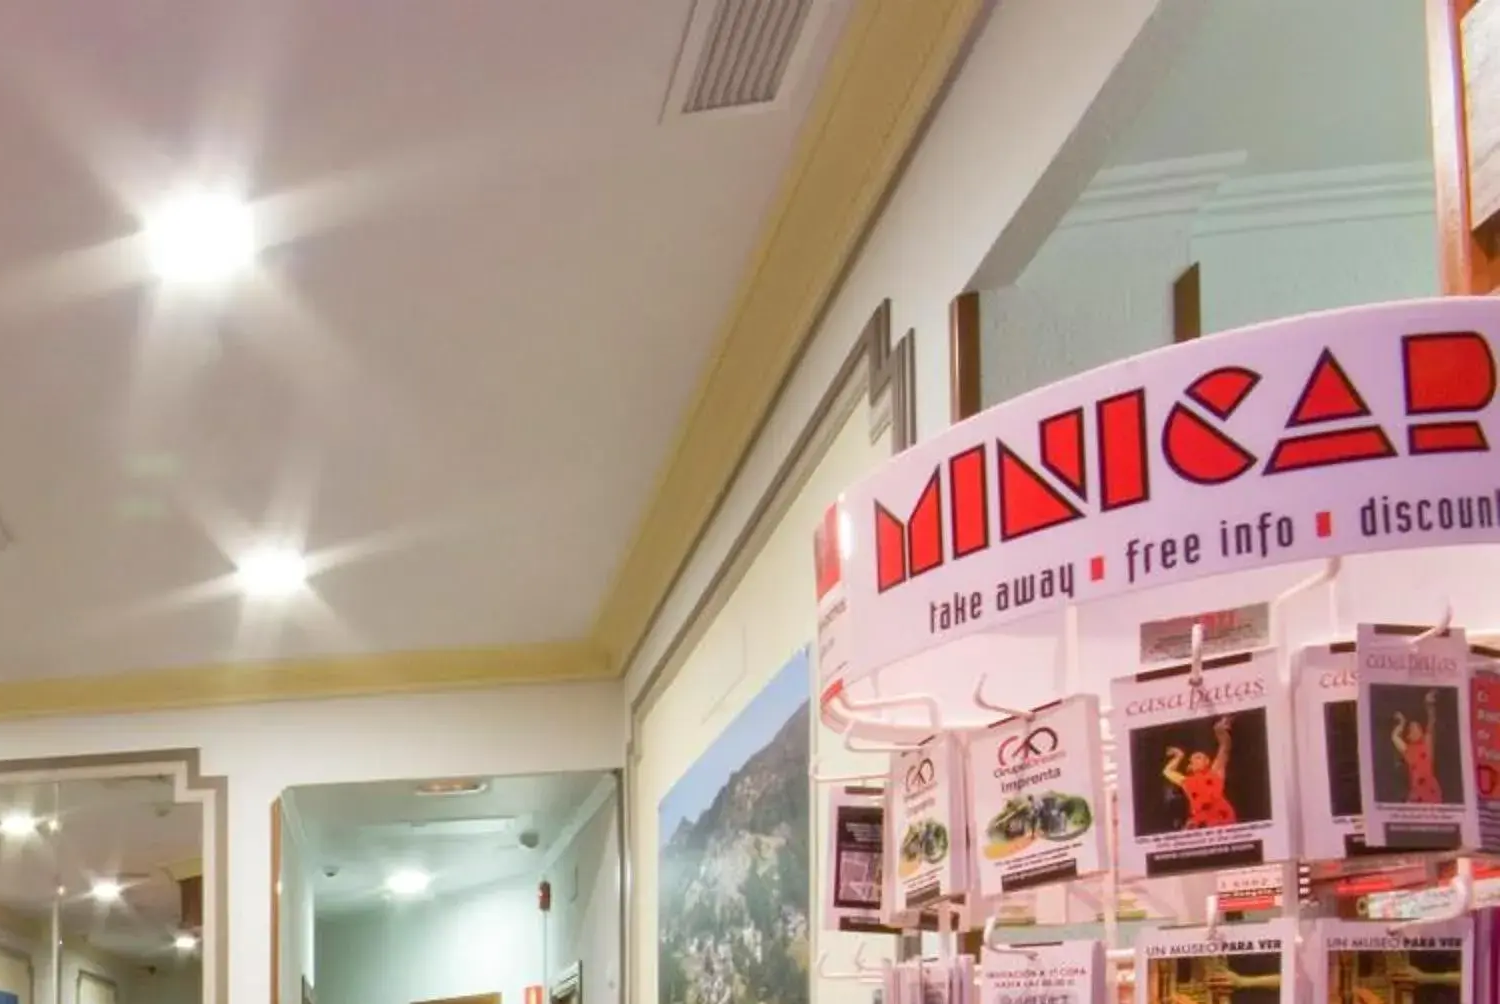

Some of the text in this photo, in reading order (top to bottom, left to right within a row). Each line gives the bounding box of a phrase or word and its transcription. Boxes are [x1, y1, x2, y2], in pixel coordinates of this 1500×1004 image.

[929, 591, 983, 634] take
[995, 562, 1075, 612] away
[1125, 532, 1201, 583] free
[1219, 511, 1295, 558] info
[1319, 669, 1358, 689] cas
[1221, 940, 1254, 952] PARA
[1257, 939, 1283, 950] VER
[1403, 937, 1437, 948] PARA
